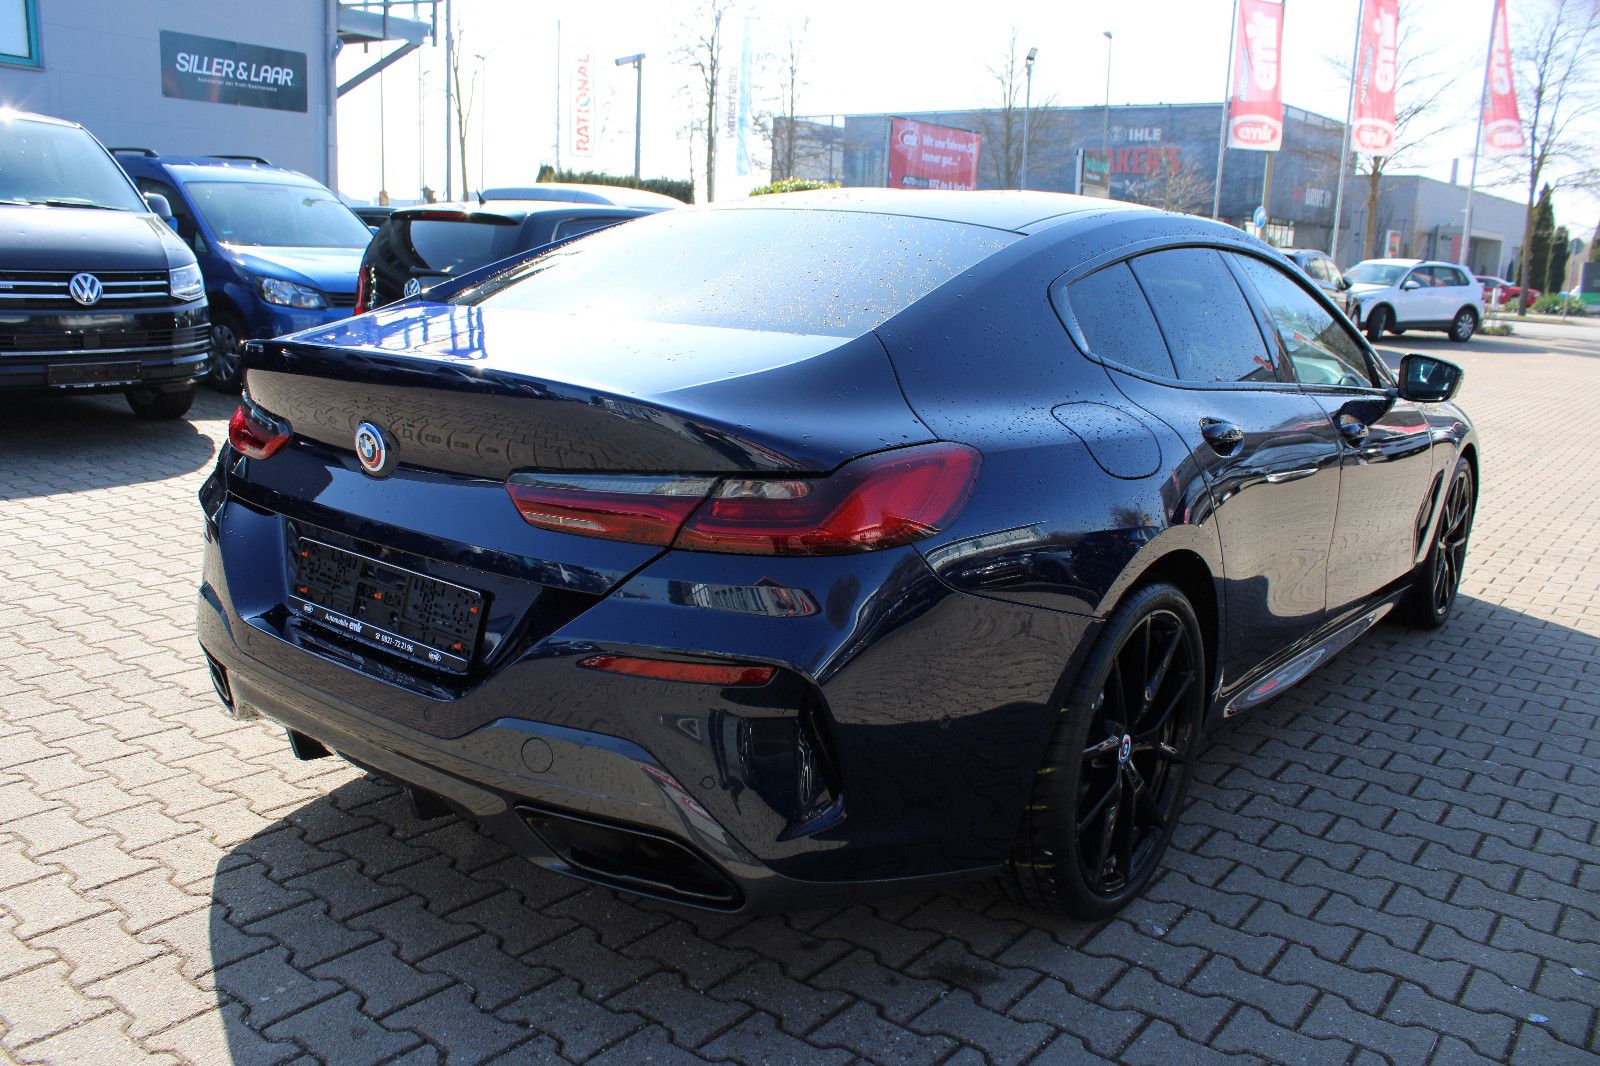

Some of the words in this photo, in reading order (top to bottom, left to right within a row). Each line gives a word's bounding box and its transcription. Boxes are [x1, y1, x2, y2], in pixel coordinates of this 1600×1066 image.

[175, 52, 235, 78] SILLER
[236, 61, 248, 81] &
[250, 63, 293, 86] LAAR
[575, 53, 590, 151] RATIONAL
[1128, 127, 1162, 141] IHLE
